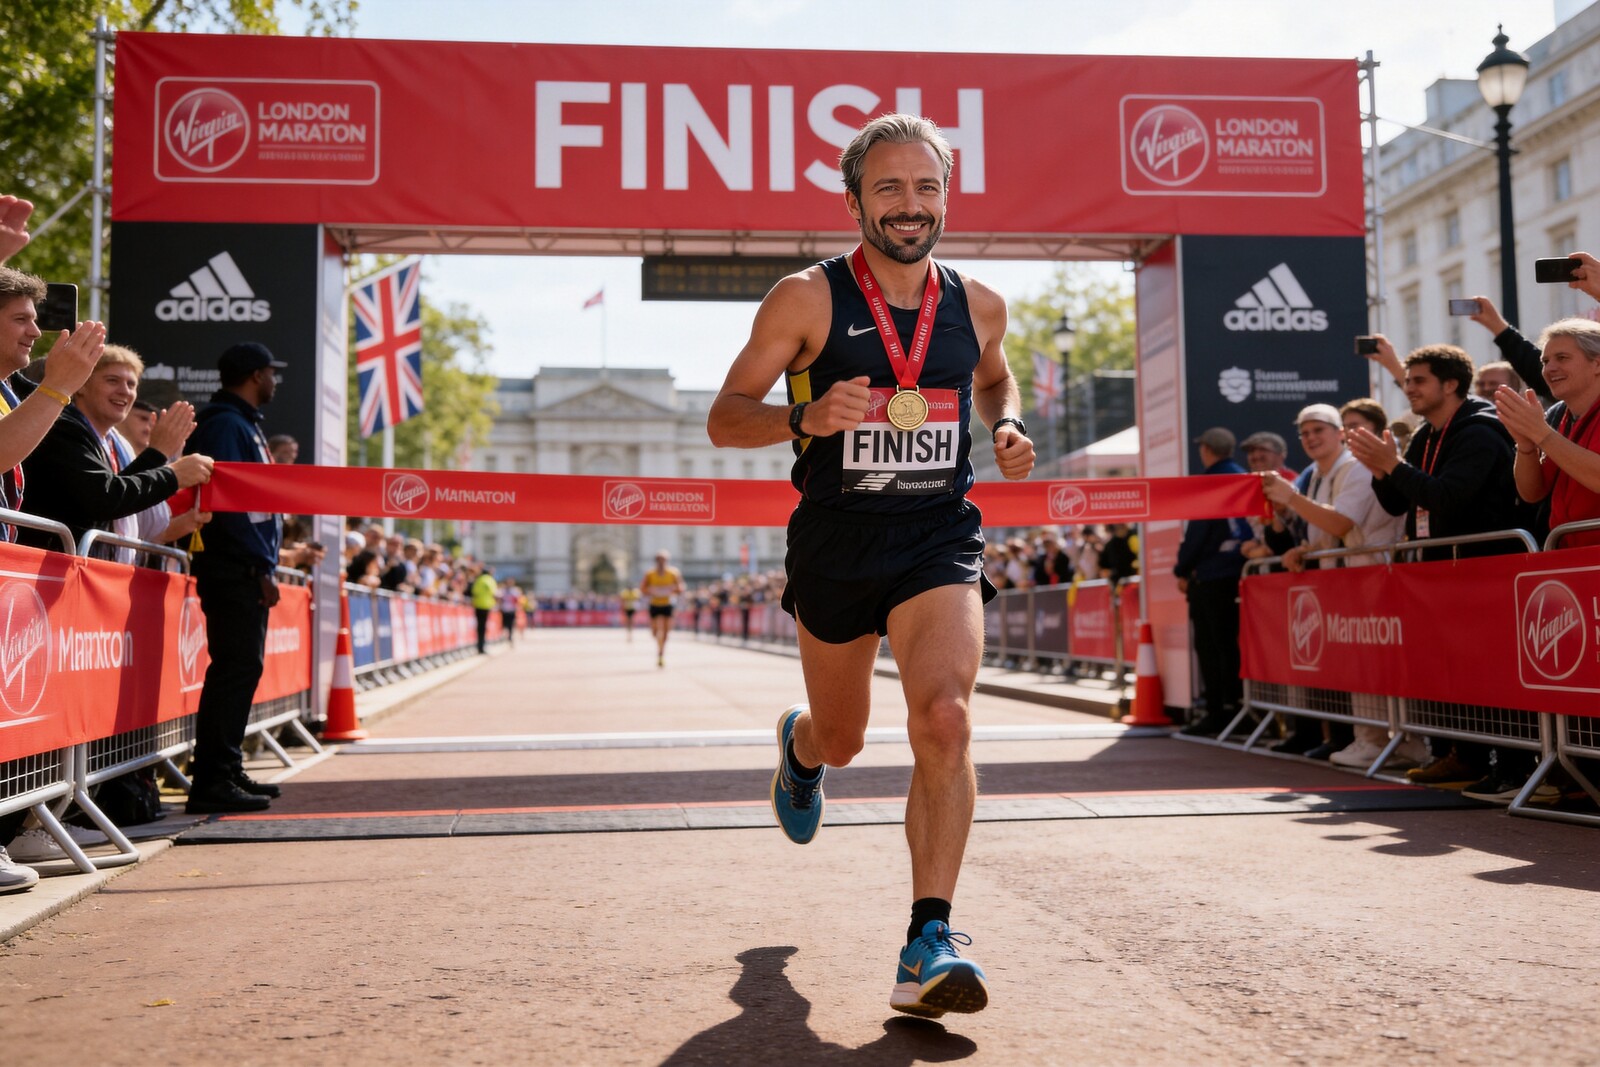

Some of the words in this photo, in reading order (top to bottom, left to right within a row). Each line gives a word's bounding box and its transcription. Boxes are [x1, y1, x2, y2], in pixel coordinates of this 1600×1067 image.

[258, 102, 350, 121] LONDON
[173, 97, 244, 163] Virgin
[258, 122, 366, 143] MARATON
[535, 80, 986, 194] FINISH
[1215, 118, 1299, 136] LONDON
[1216, 138, 1314, 158] MARATON
[154, 294, 271, 322] adidas
[1223, 305, 1329, 332] adidas
[852, 429, 952, 463] FINISH
[649, 491, 704, 503] LONDON
